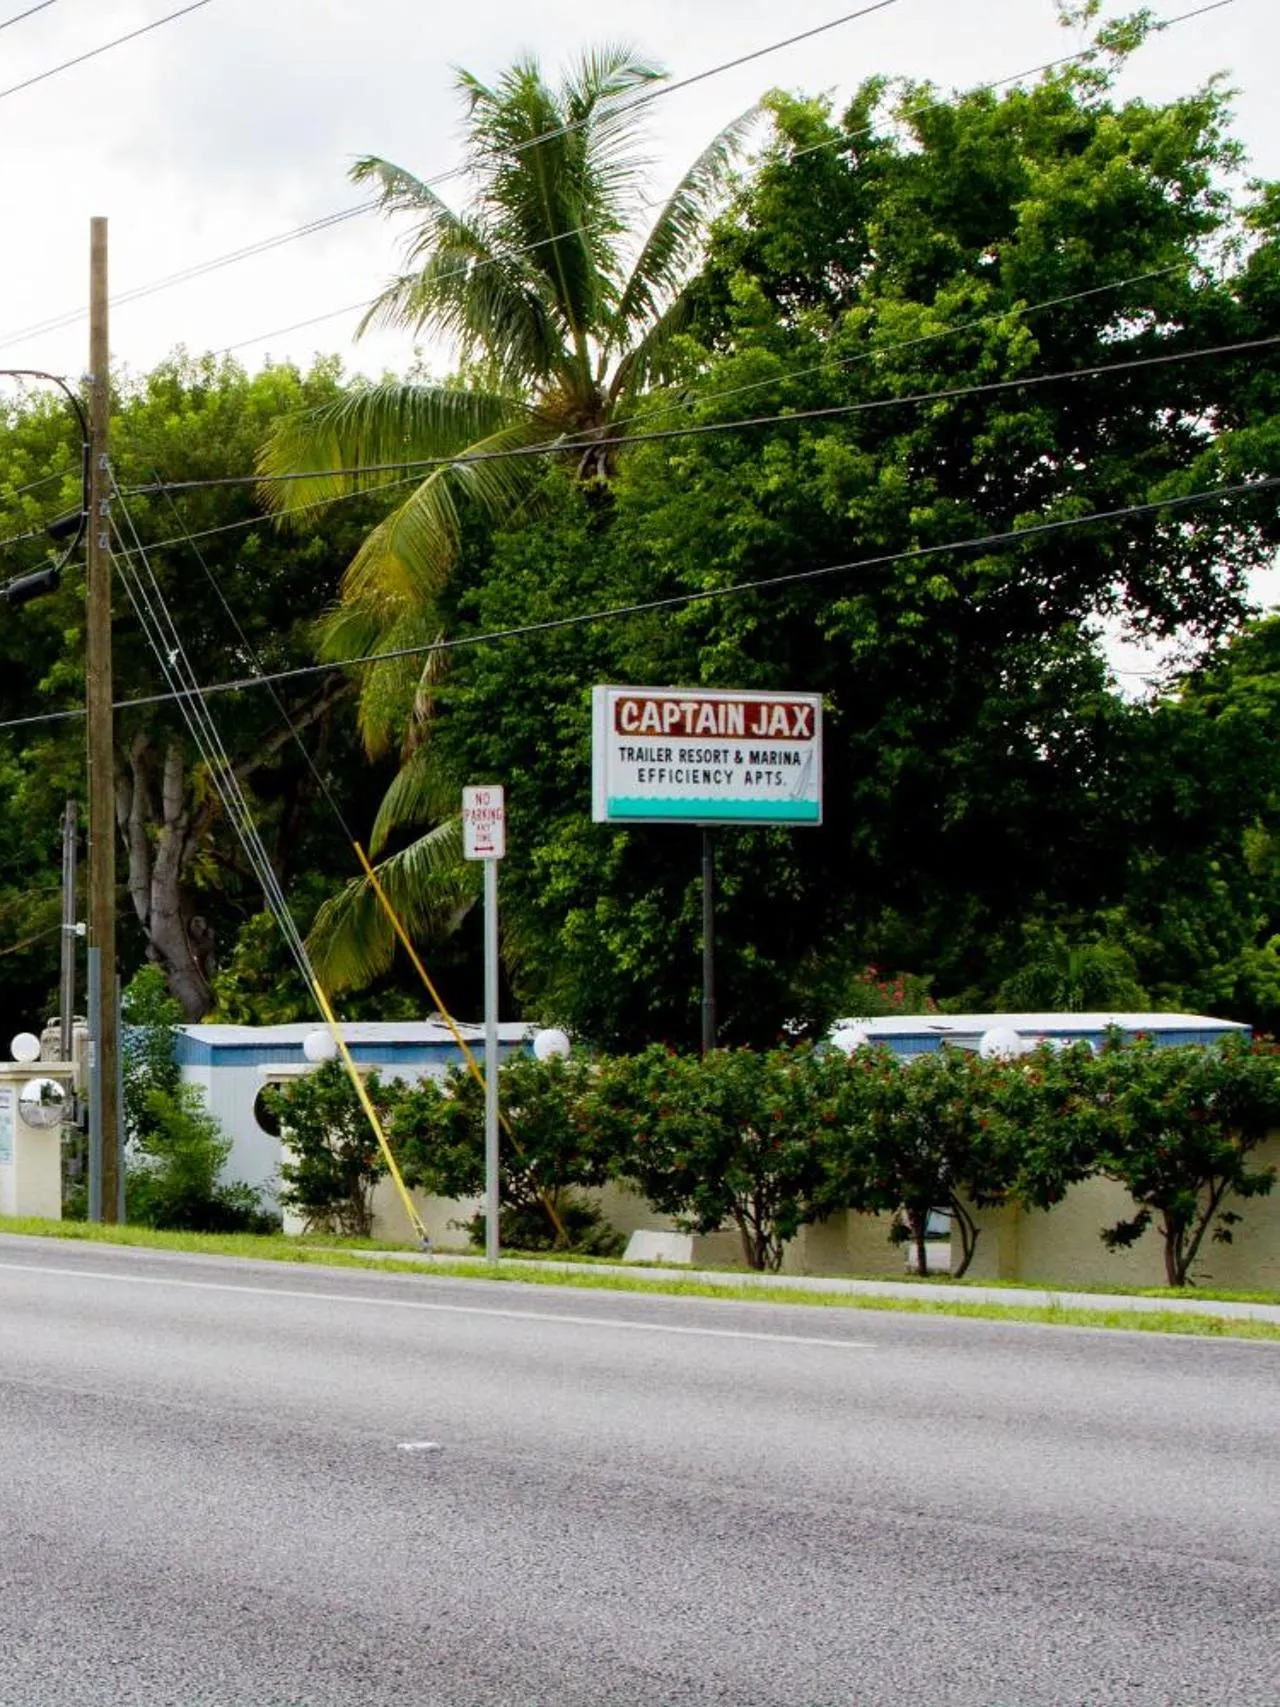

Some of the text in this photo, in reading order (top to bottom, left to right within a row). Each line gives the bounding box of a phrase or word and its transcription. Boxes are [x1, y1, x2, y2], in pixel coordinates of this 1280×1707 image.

[620, 700, 811, 737] CAPTAIN JAX
[619, 746, 802, 766] TRAILER RESORT & MARINA
[637, 768, 787, 787] EFFICIENCY APTS.
[475, 792, 490, 805] NO
[464, 808, 503, 820] PARKING
